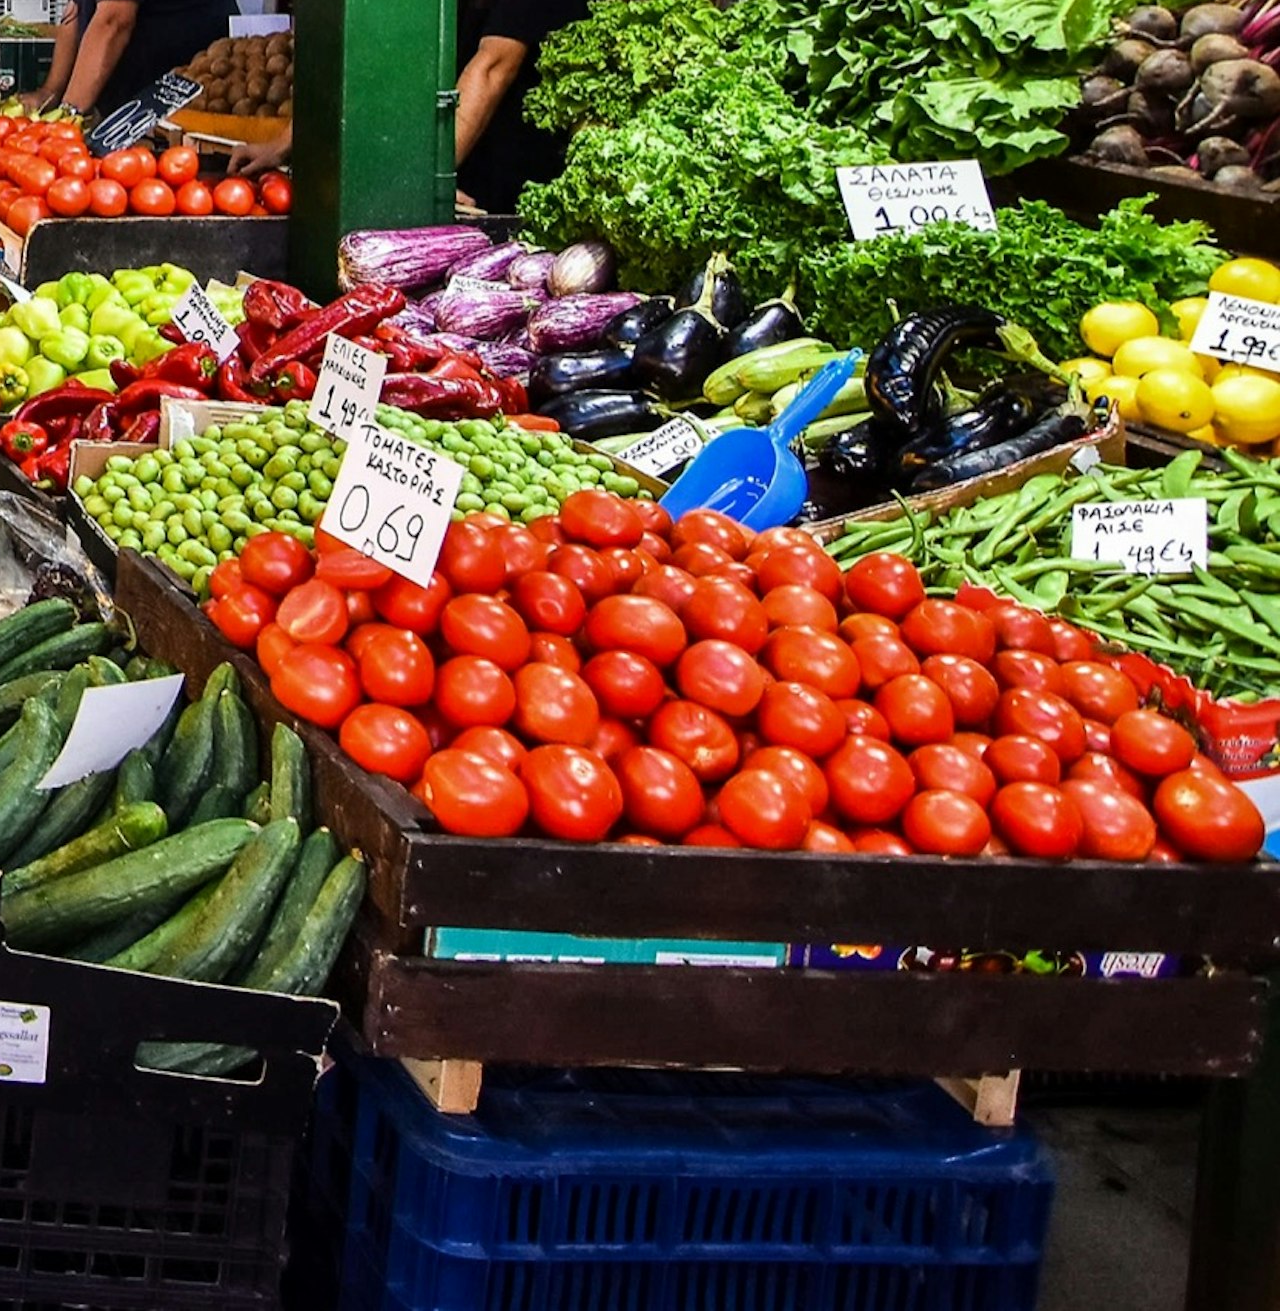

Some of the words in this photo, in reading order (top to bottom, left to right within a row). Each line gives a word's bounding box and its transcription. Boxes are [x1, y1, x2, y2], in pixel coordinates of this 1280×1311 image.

[849, 165, 958, 186] ΣΑΛΑΤΑ
[333, 337, 367, 372] ΕΛΙΕΣ
[360, 424, 438, 478] ΤΟΜΑΤΕΣ
[366, 452, 445, 507] ΚΑΣΤΟΡΙΑΣ
[1078, 502, 1174, 521] ΦΑΣΟΛΑΚΙΑ
